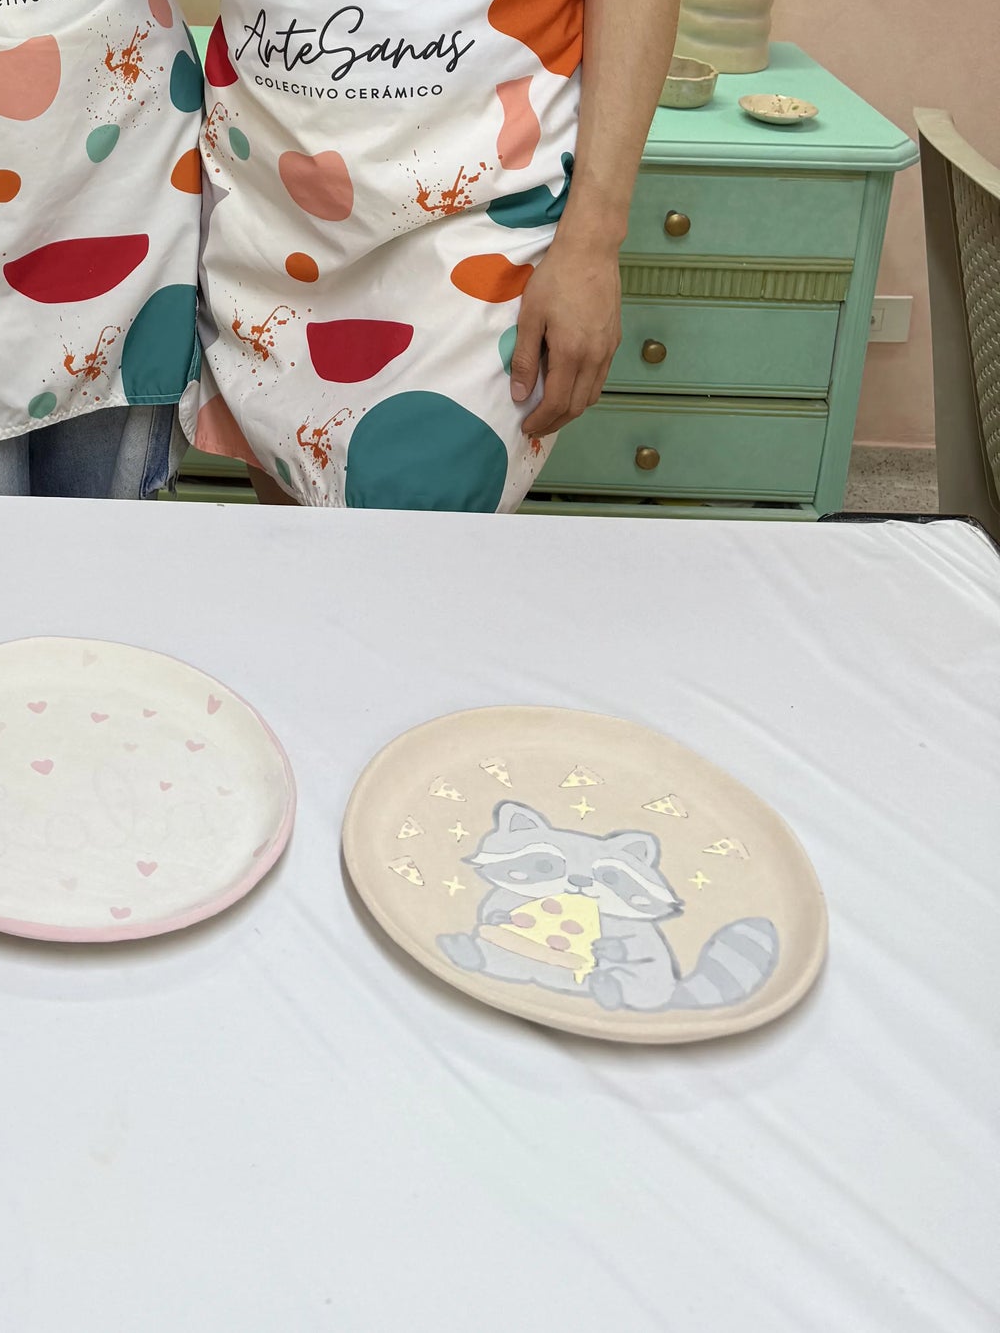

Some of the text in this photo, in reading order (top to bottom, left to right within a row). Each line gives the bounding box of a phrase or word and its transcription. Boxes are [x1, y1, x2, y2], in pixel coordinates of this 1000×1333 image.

[235, 5, 476, 82] ArteSanas
[254, 75, 444, 100] COLECTIVO CERÁMICO
